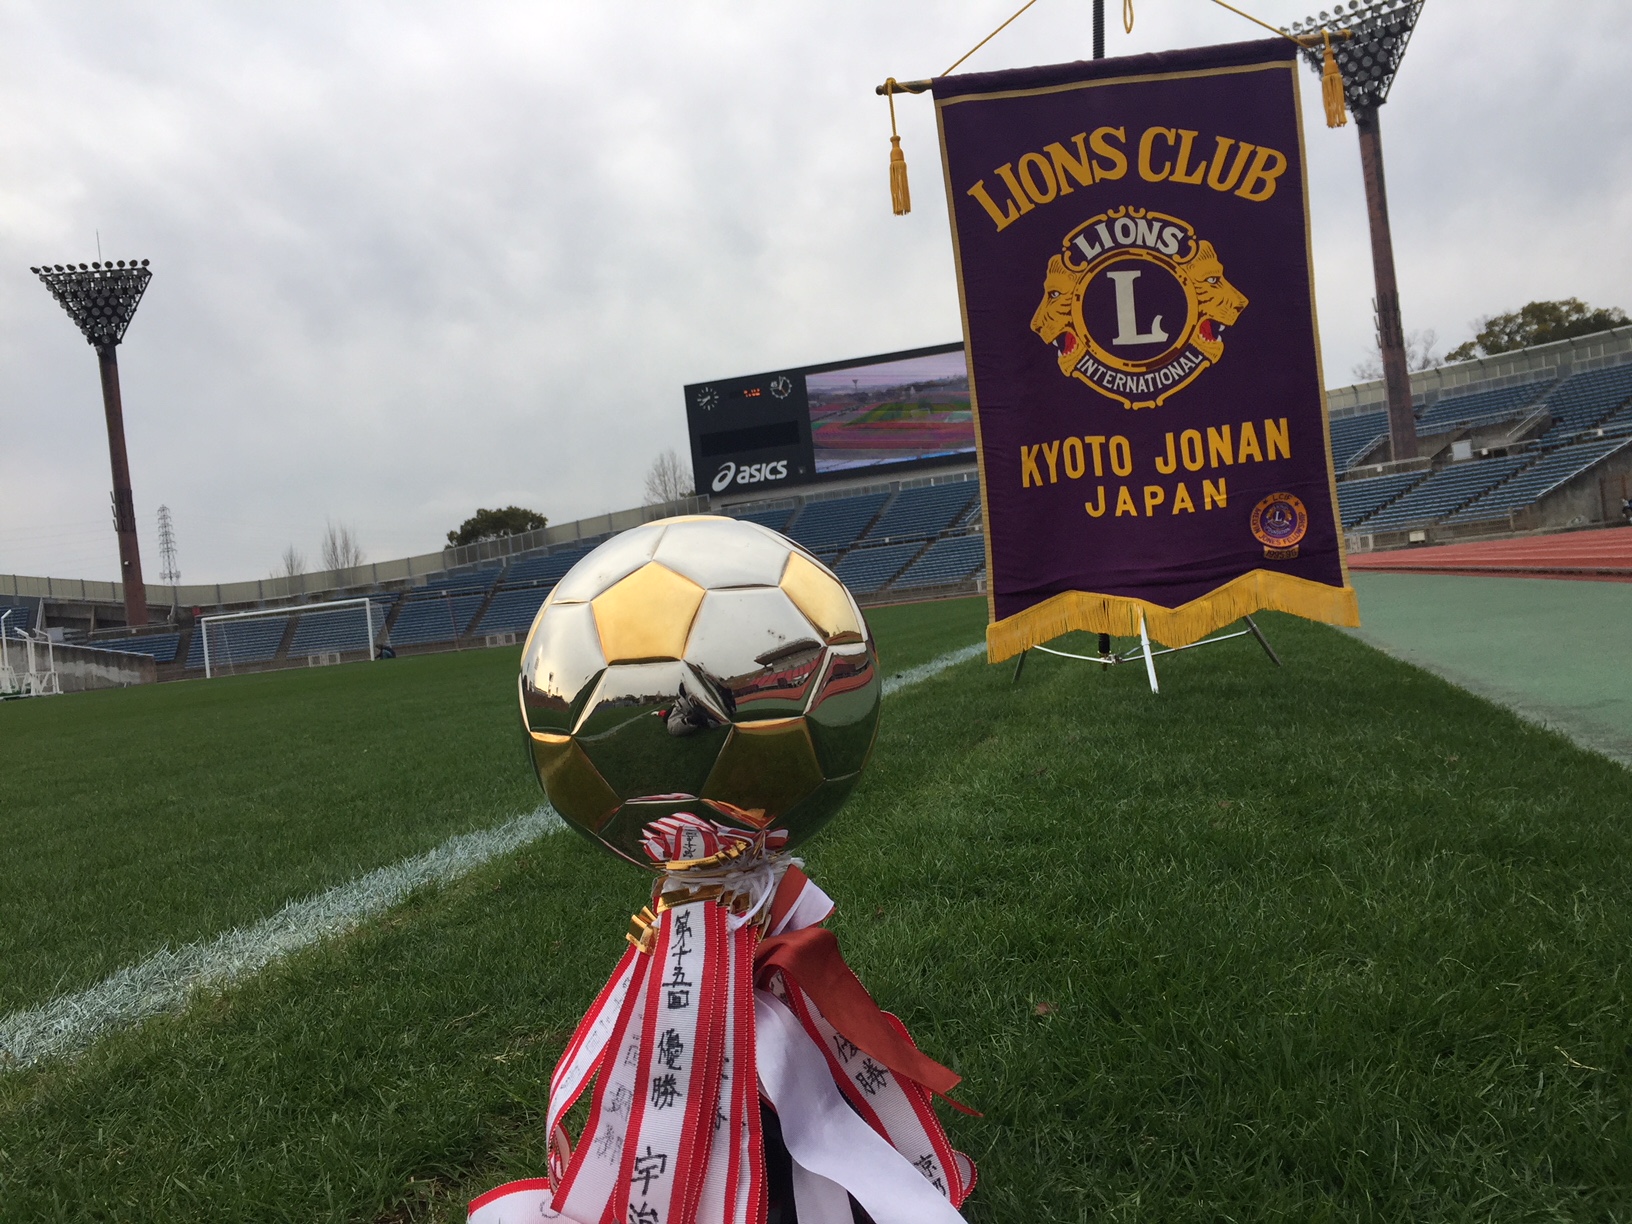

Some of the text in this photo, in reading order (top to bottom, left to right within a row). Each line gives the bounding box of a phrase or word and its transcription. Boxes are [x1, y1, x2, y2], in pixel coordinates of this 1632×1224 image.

[968, 126, 1288, 231] LIONS CLUB
[1073, 217, 1185, 261] LIONS
[1106, 270, 1169, 345] L
[1077, 351, 1203, 393] INTERNATIONAL
[736, 460, 788, 484] asics
[1021, 418, 1290, 487] KYOTO JONAN
[1086, 478, 1227, 517] JAPAN
[1272, 493, 1292, 501] LCIF
